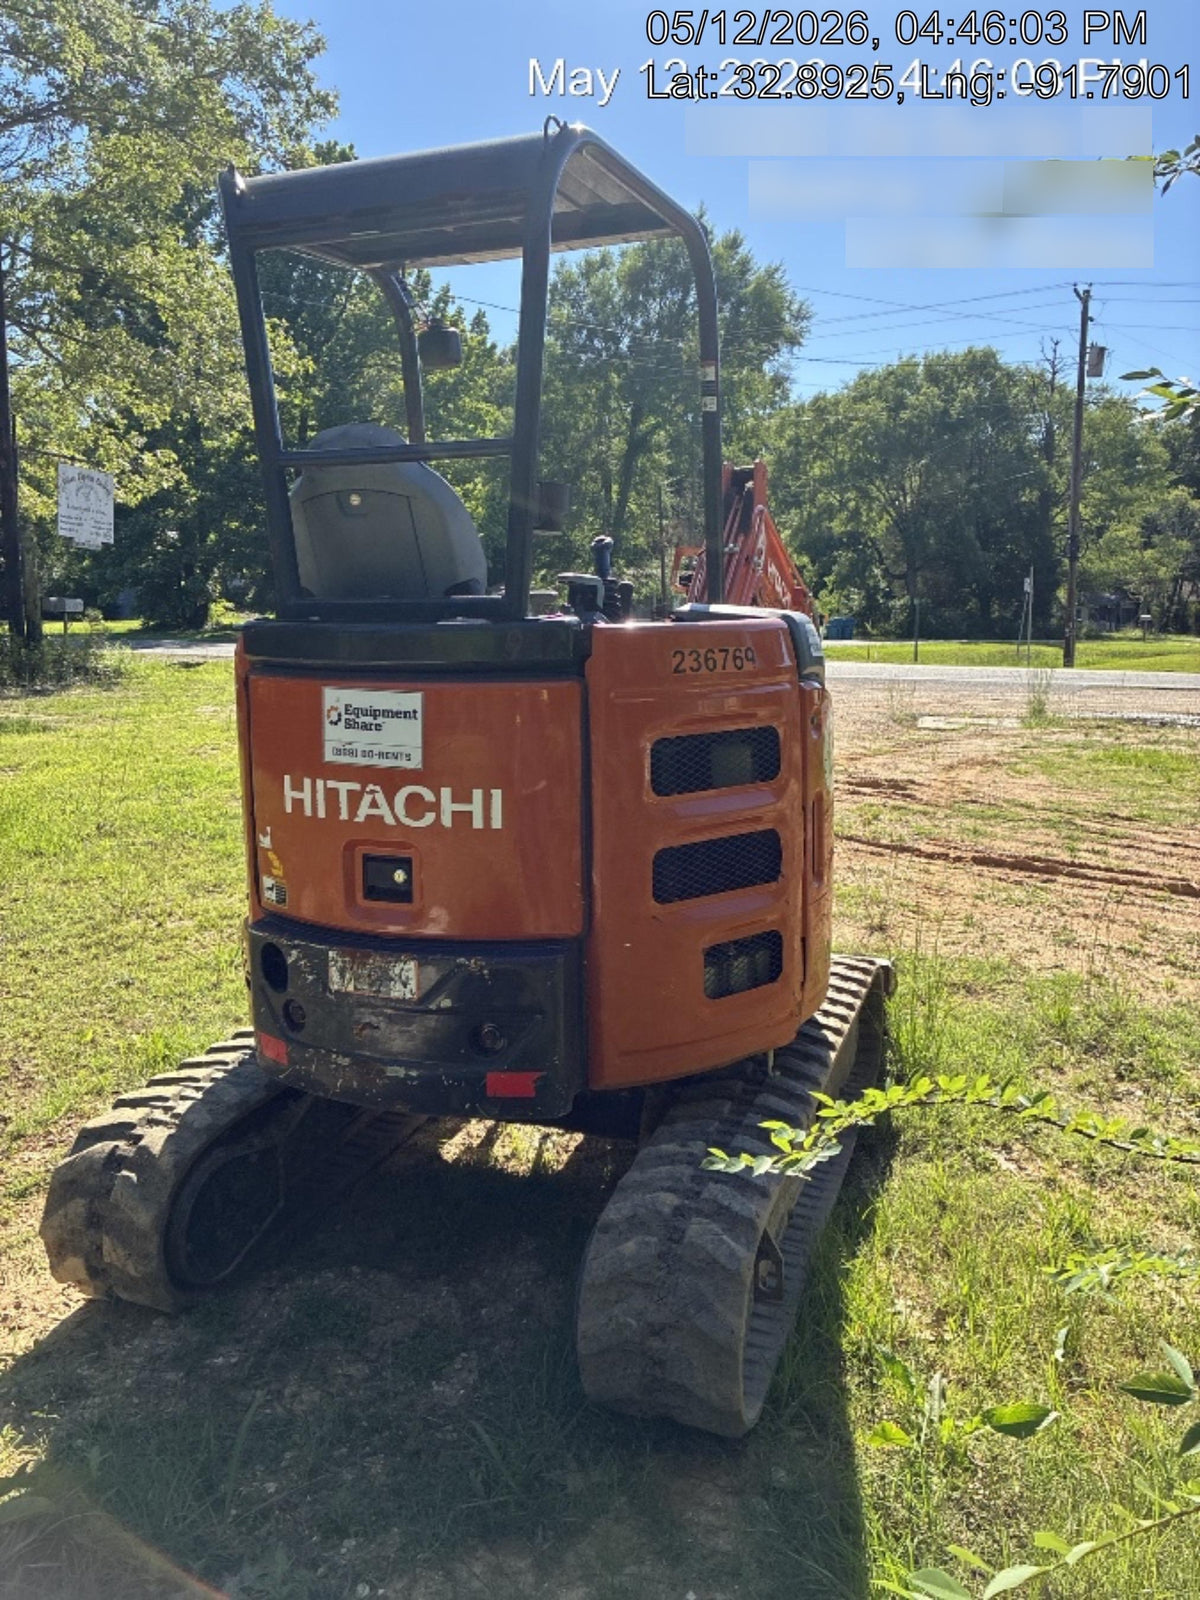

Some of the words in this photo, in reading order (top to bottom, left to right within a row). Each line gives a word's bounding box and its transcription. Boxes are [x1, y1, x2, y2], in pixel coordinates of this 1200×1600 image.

[344, 703, 418, 720] Equipment
[344, 717, 383, 731] Share
[284, 774, 502, 829] HITACHI
